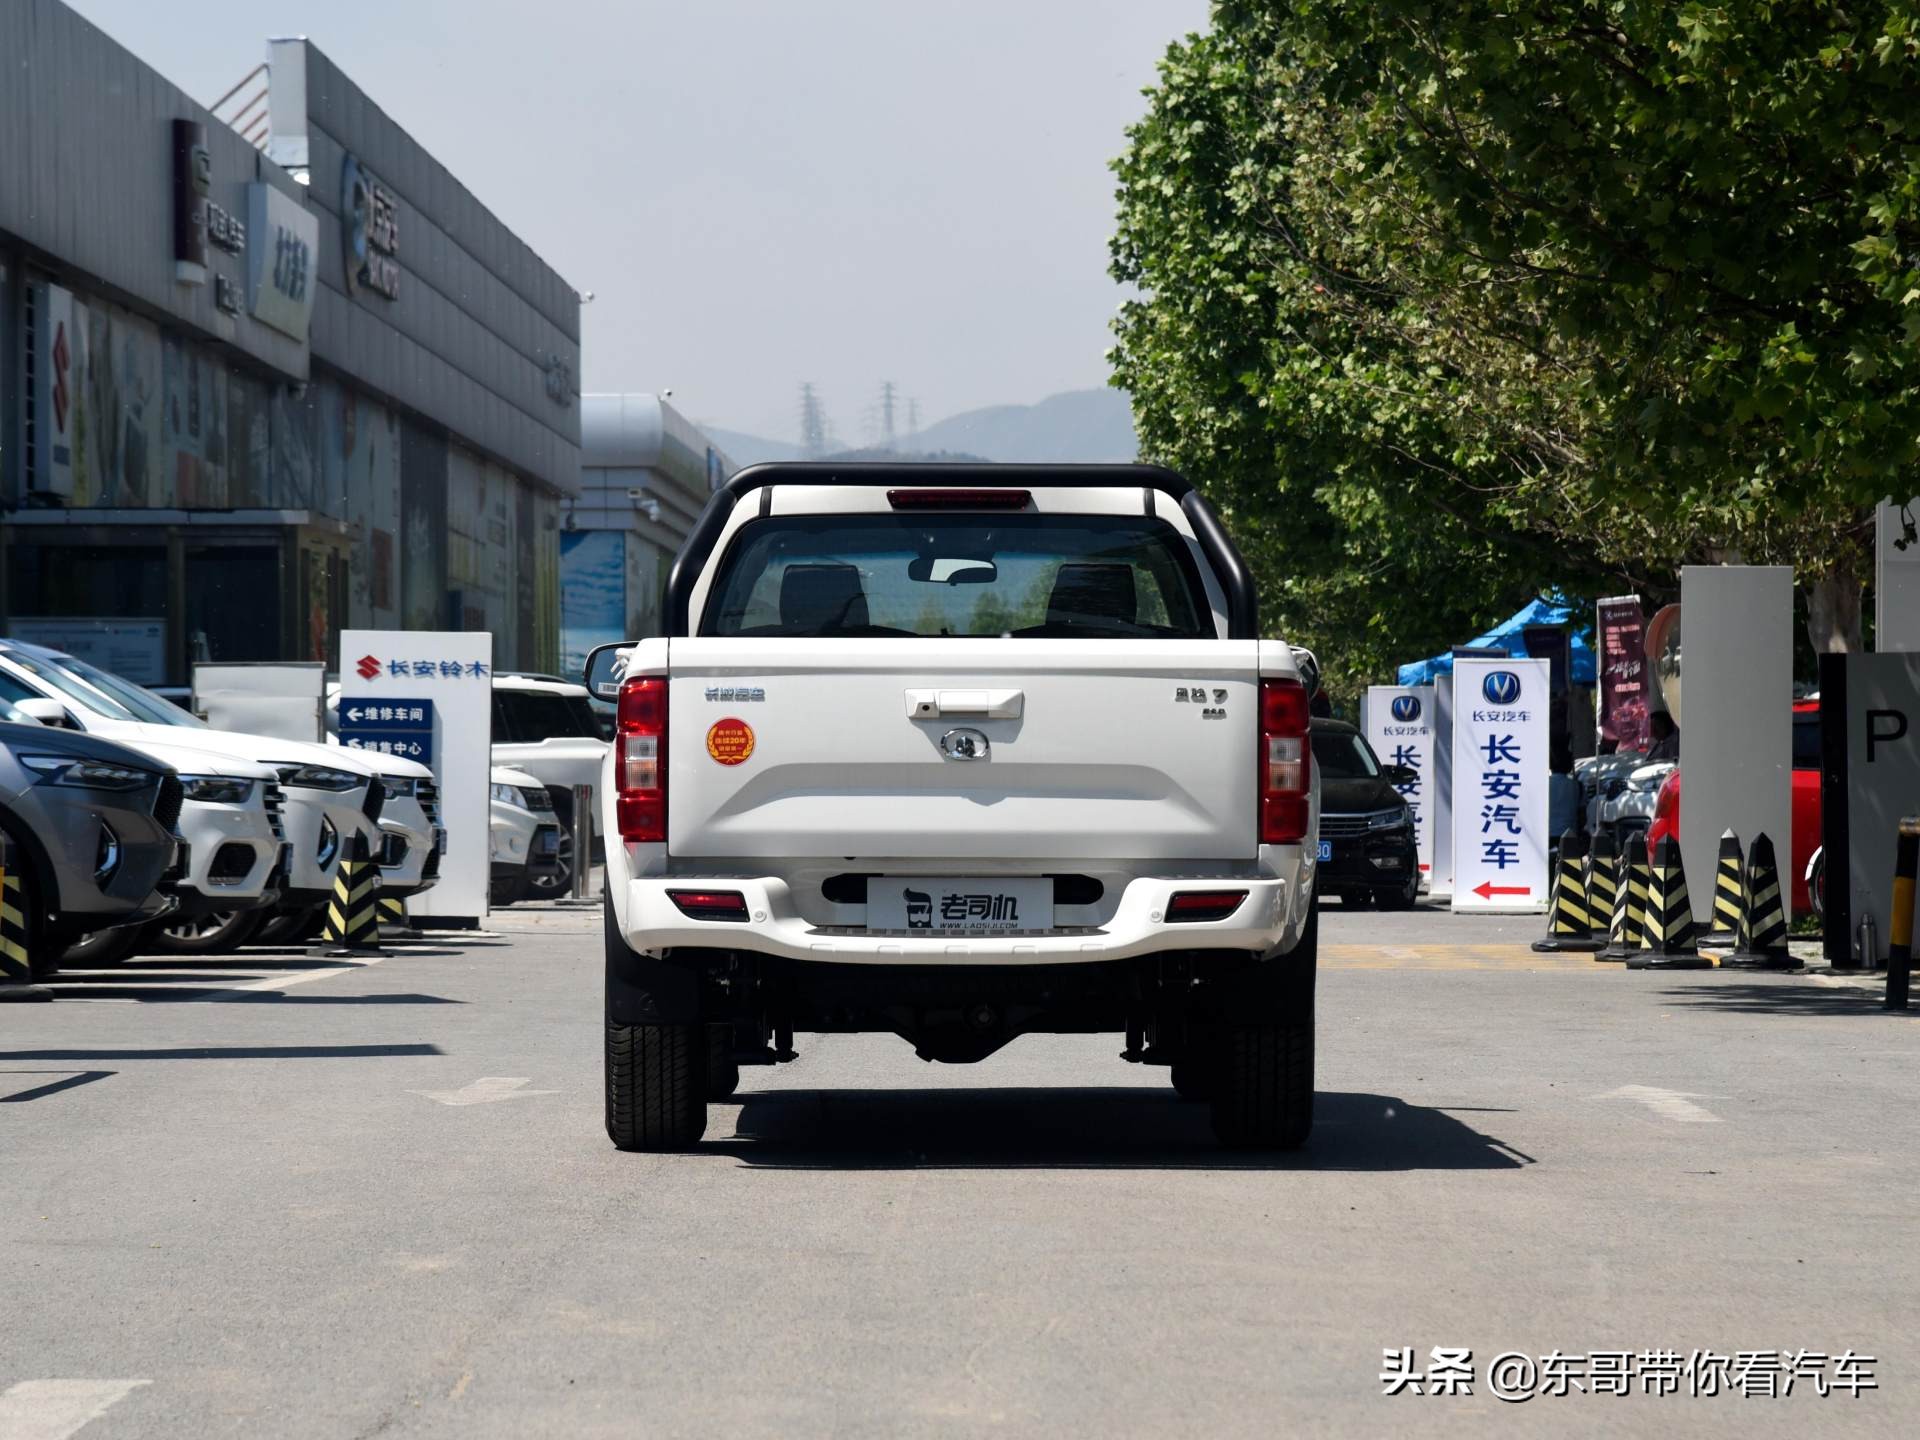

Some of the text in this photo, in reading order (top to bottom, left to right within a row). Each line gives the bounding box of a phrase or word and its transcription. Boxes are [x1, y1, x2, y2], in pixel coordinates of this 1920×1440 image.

[387, 659, 489, 678] 长安铃木
[364, 706, 423, 721] 维修车间
[1473, 711, 1532, 722] 长安汽车
[1383, 726, 1430, 736] 长安汽车
[1866, 709, 1908, 763] P
[1480, 734, 1522, 870] 长安汽车
[940, 893, 1019, 920] 老司机
